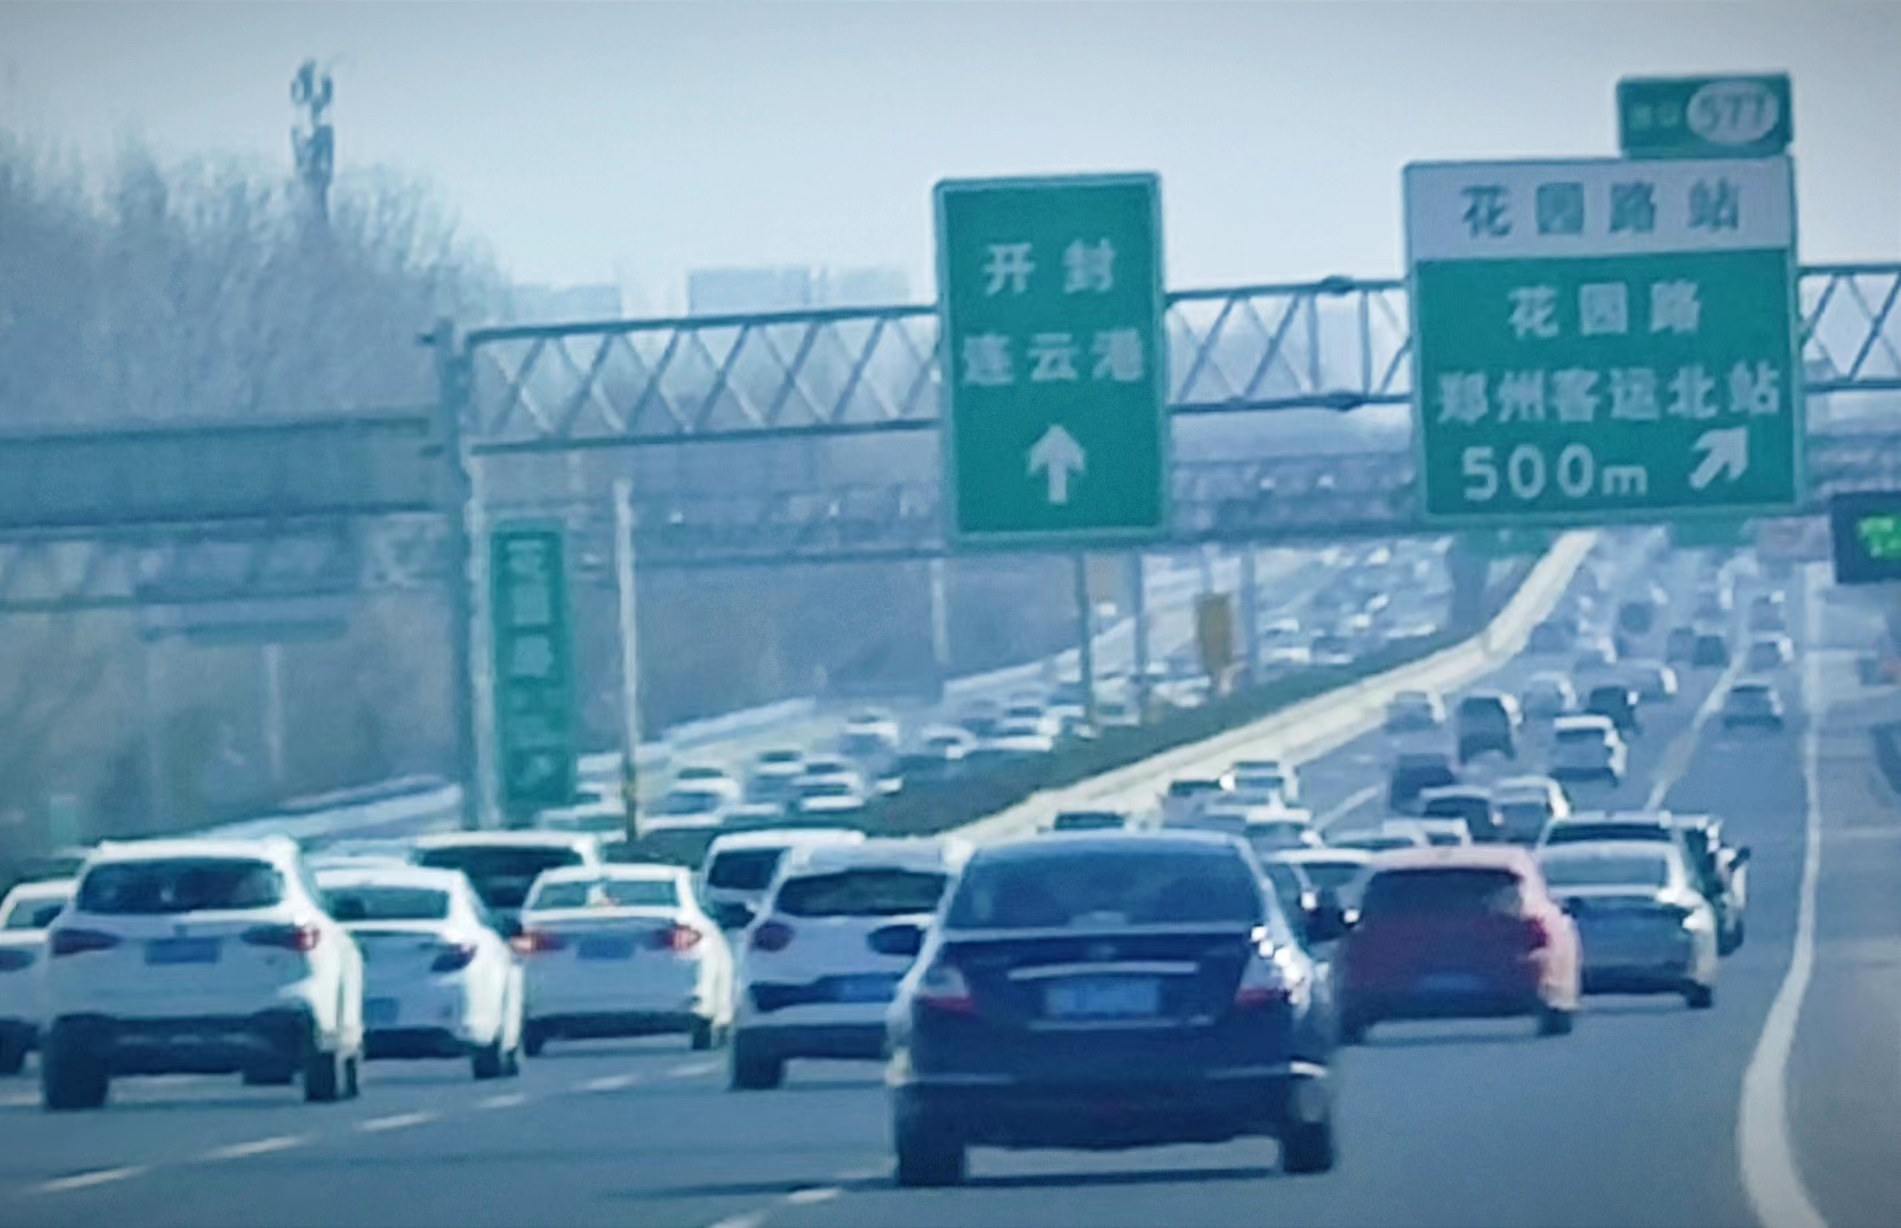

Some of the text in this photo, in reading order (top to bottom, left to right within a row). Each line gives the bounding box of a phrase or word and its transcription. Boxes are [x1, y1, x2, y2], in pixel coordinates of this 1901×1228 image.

[1461, 178, 1740, 238] 花园路站
[983, 237, 1117, 295] 开封
[1507, 280, 1701, 339] 花园路
[1437, 360, 1780, 423] 郑州客运北站
[1461, 443, 1648, 501] 500m
